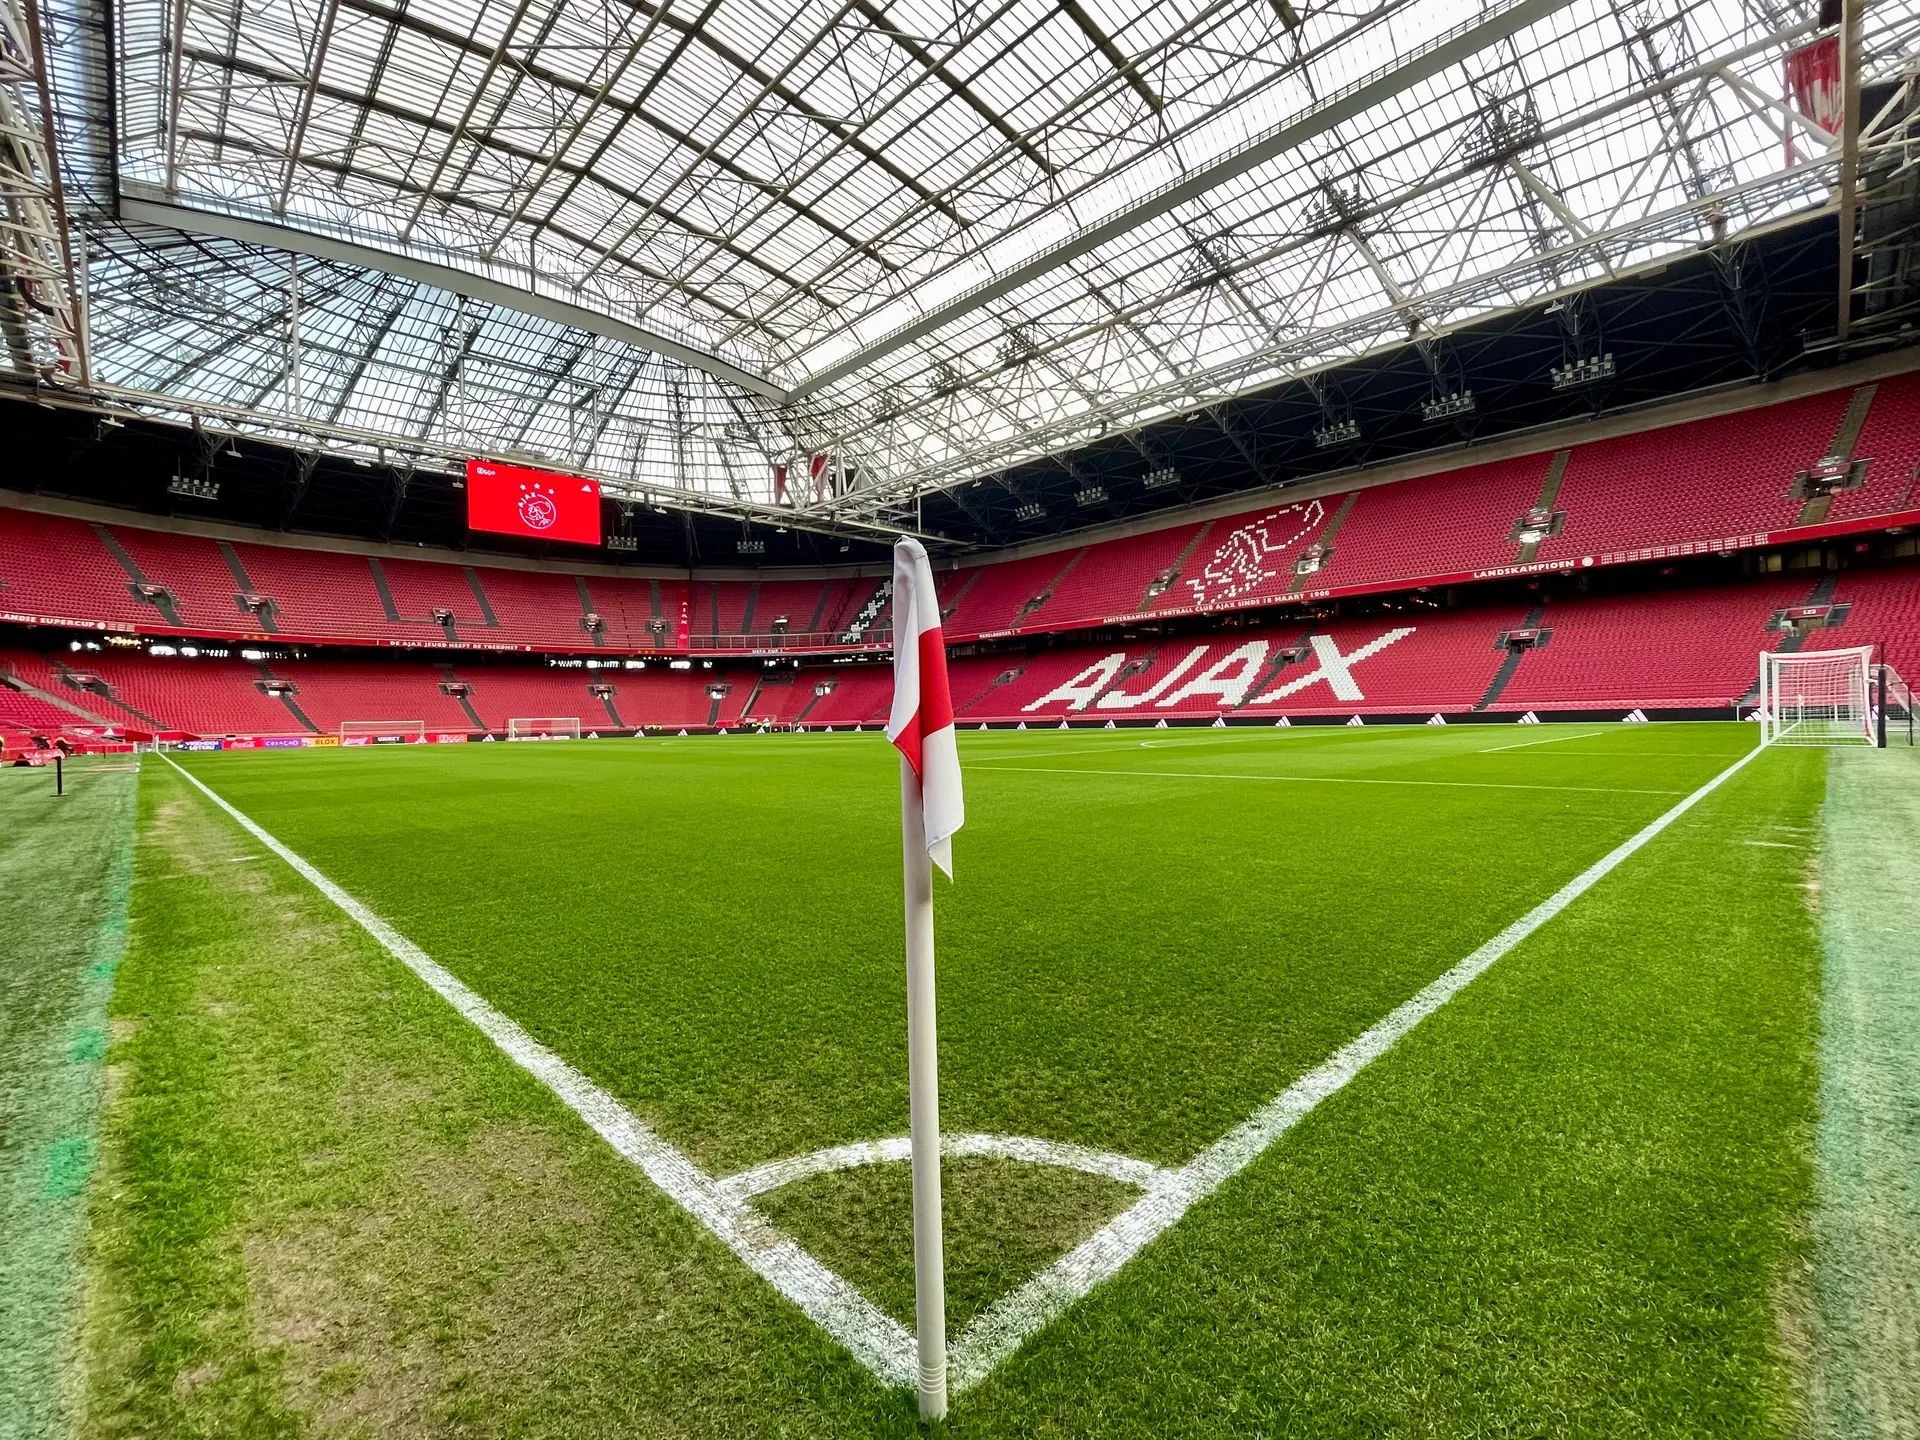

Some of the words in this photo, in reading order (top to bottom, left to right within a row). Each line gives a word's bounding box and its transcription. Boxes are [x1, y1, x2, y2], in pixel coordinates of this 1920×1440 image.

[518, 492, 537, 508] AJAX
[1473, 560, 1575, 579] LANDSKAMPIOEN
[1103, 612, 1157, 624] AMSTERDAMSCHE
[1159, 608, 1193, 617] FOOTBALL
[1195, 604, 1214, 612] CLUB
[1216, 602, 1235, 610] AJAX
[1238, 599, 1260, 607] SINDS
[1275, 594, 1304, 603] MAART
[1310, 590, 1330, 598] 1900
[40, 617, 95, 628] SUPERCUP
[1021, 627, 1416, 711] AJAX
